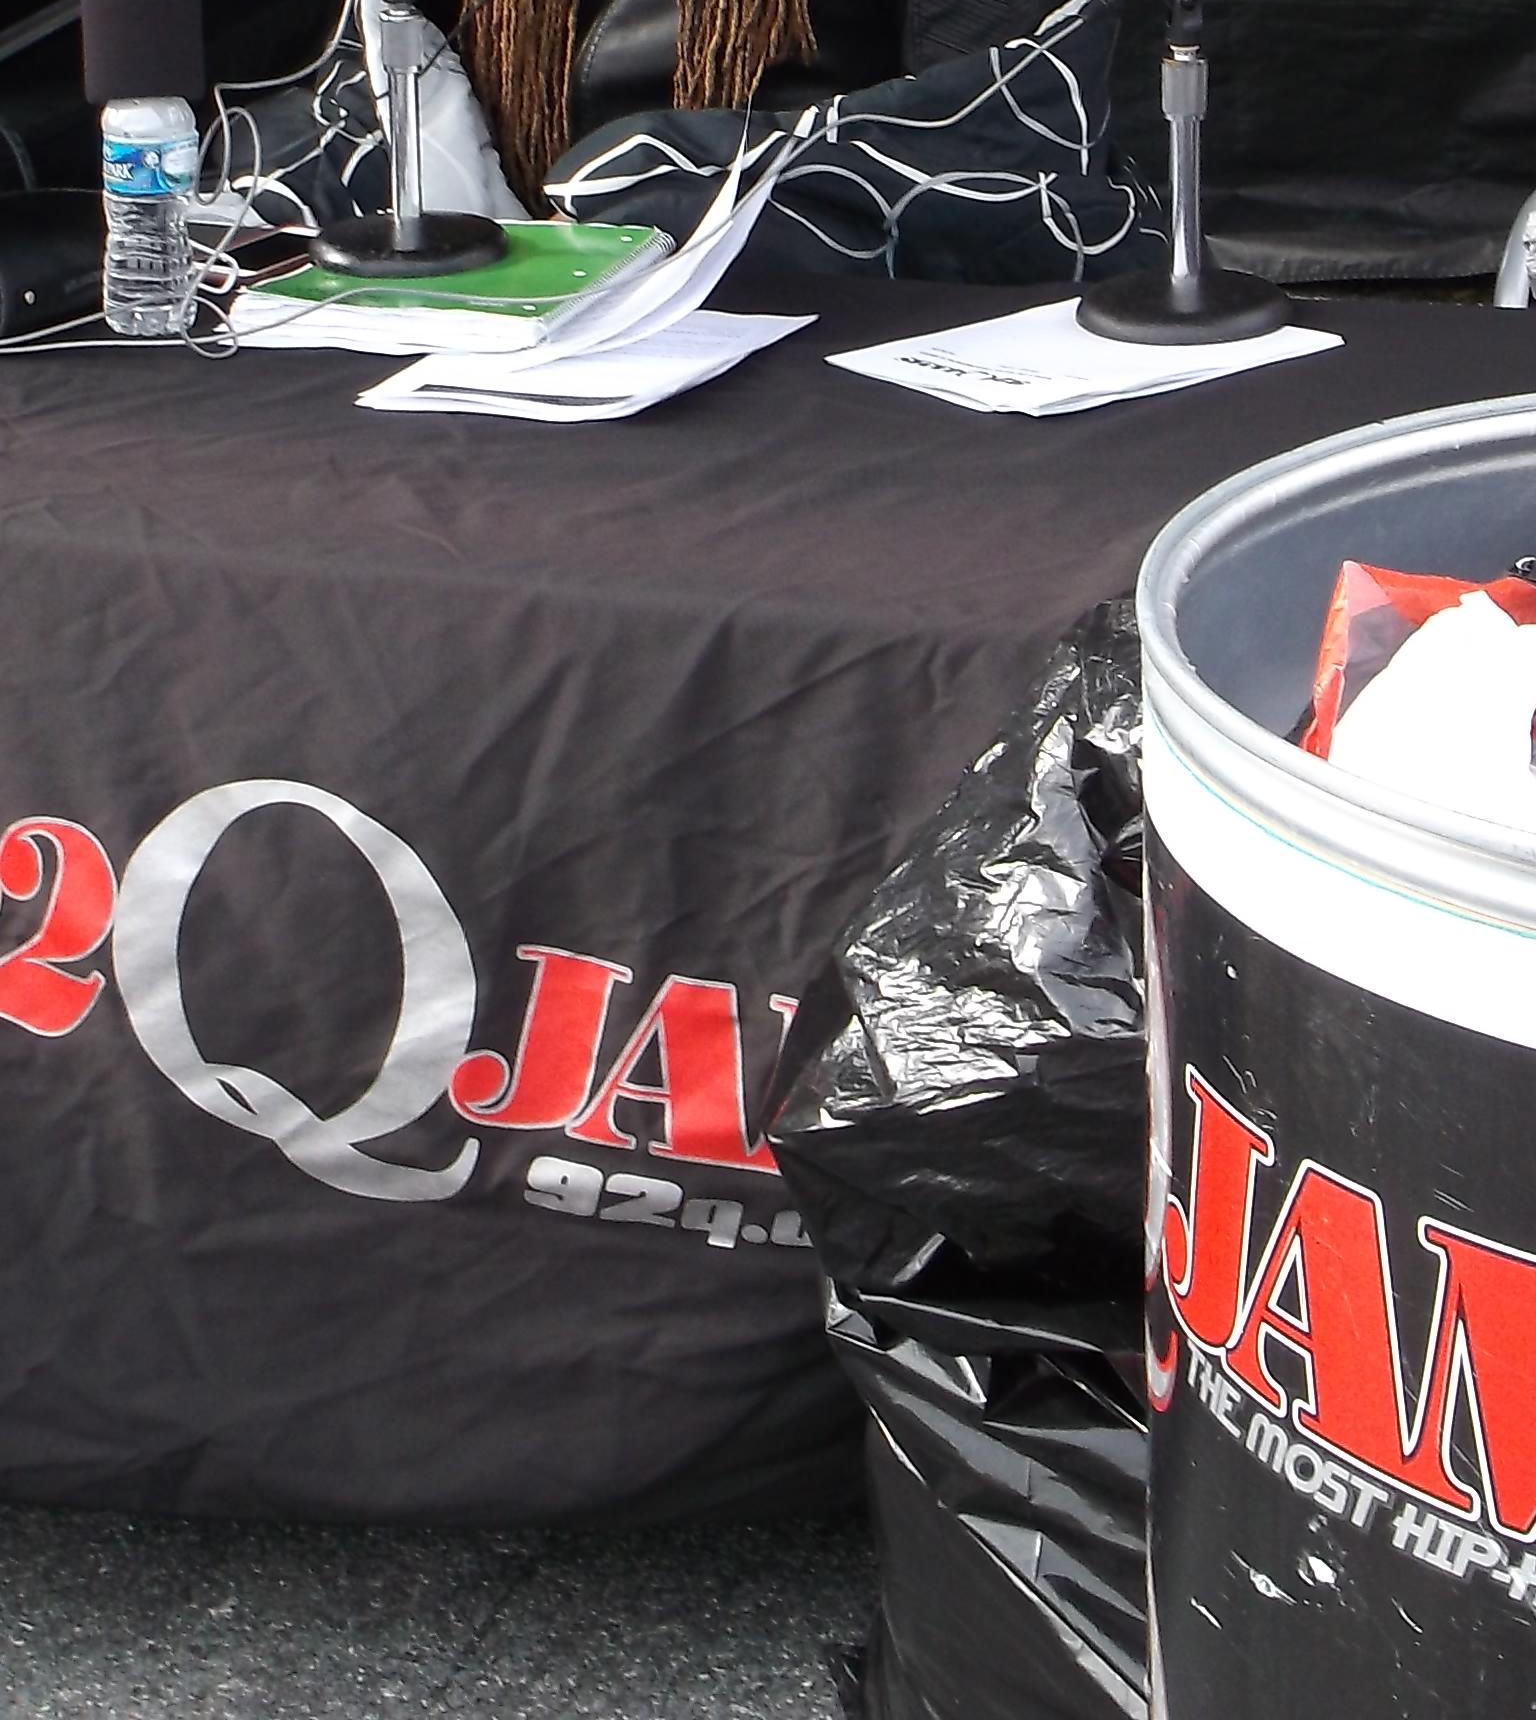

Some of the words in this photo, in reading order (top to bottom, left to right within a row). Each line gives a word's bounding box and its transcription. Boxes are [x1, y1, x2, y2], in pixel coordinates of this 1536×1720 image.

[447, 943, 800, 1177] JA
[524, 1155, 814, 1249] 92q.c
[1186, 1338, 1242, 1439] THE
[1244, 1411, 1390, 1530] MOST
